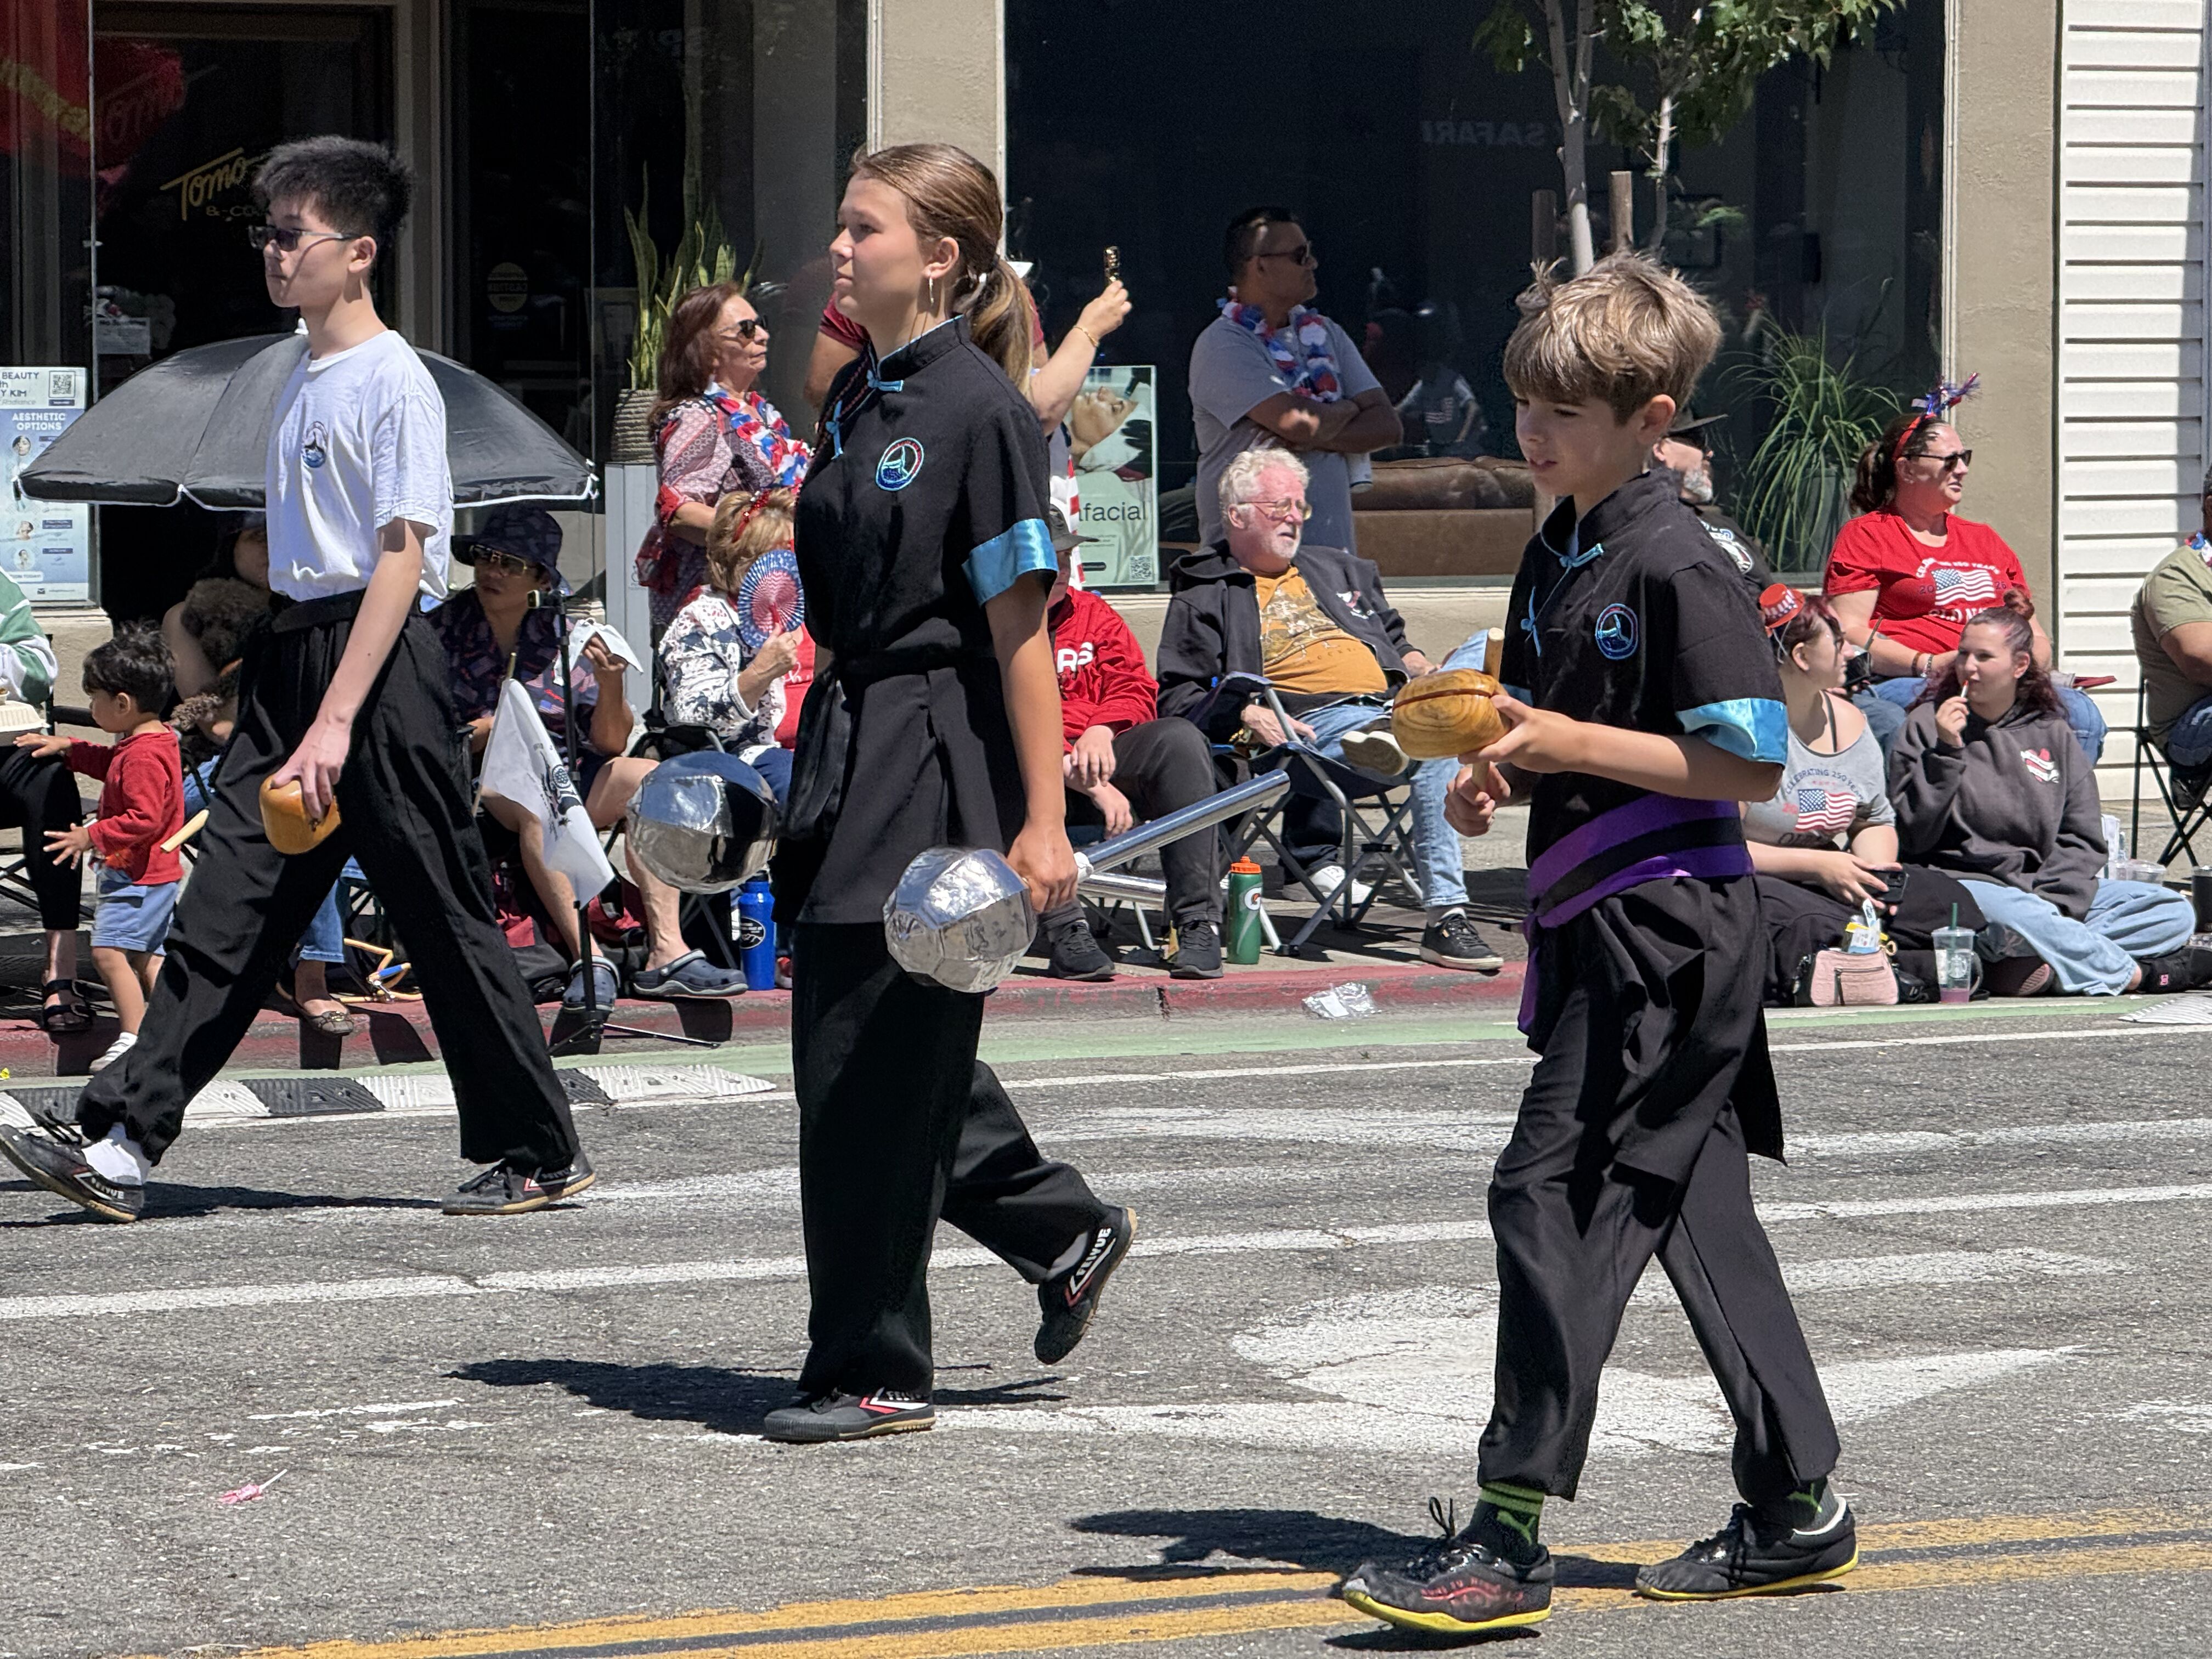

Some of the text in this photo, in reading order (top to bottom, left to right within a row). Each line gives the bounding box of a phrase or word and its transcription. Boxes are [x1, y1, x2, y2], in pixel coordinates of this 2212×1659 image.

[12, 412, 66, 421] AESTHETIC
[16, 422, 62, 431] OPTIONS
[1832, 771, 1847, 782] 250
[1075, 1228, 1111, 1277] FEIYUE
